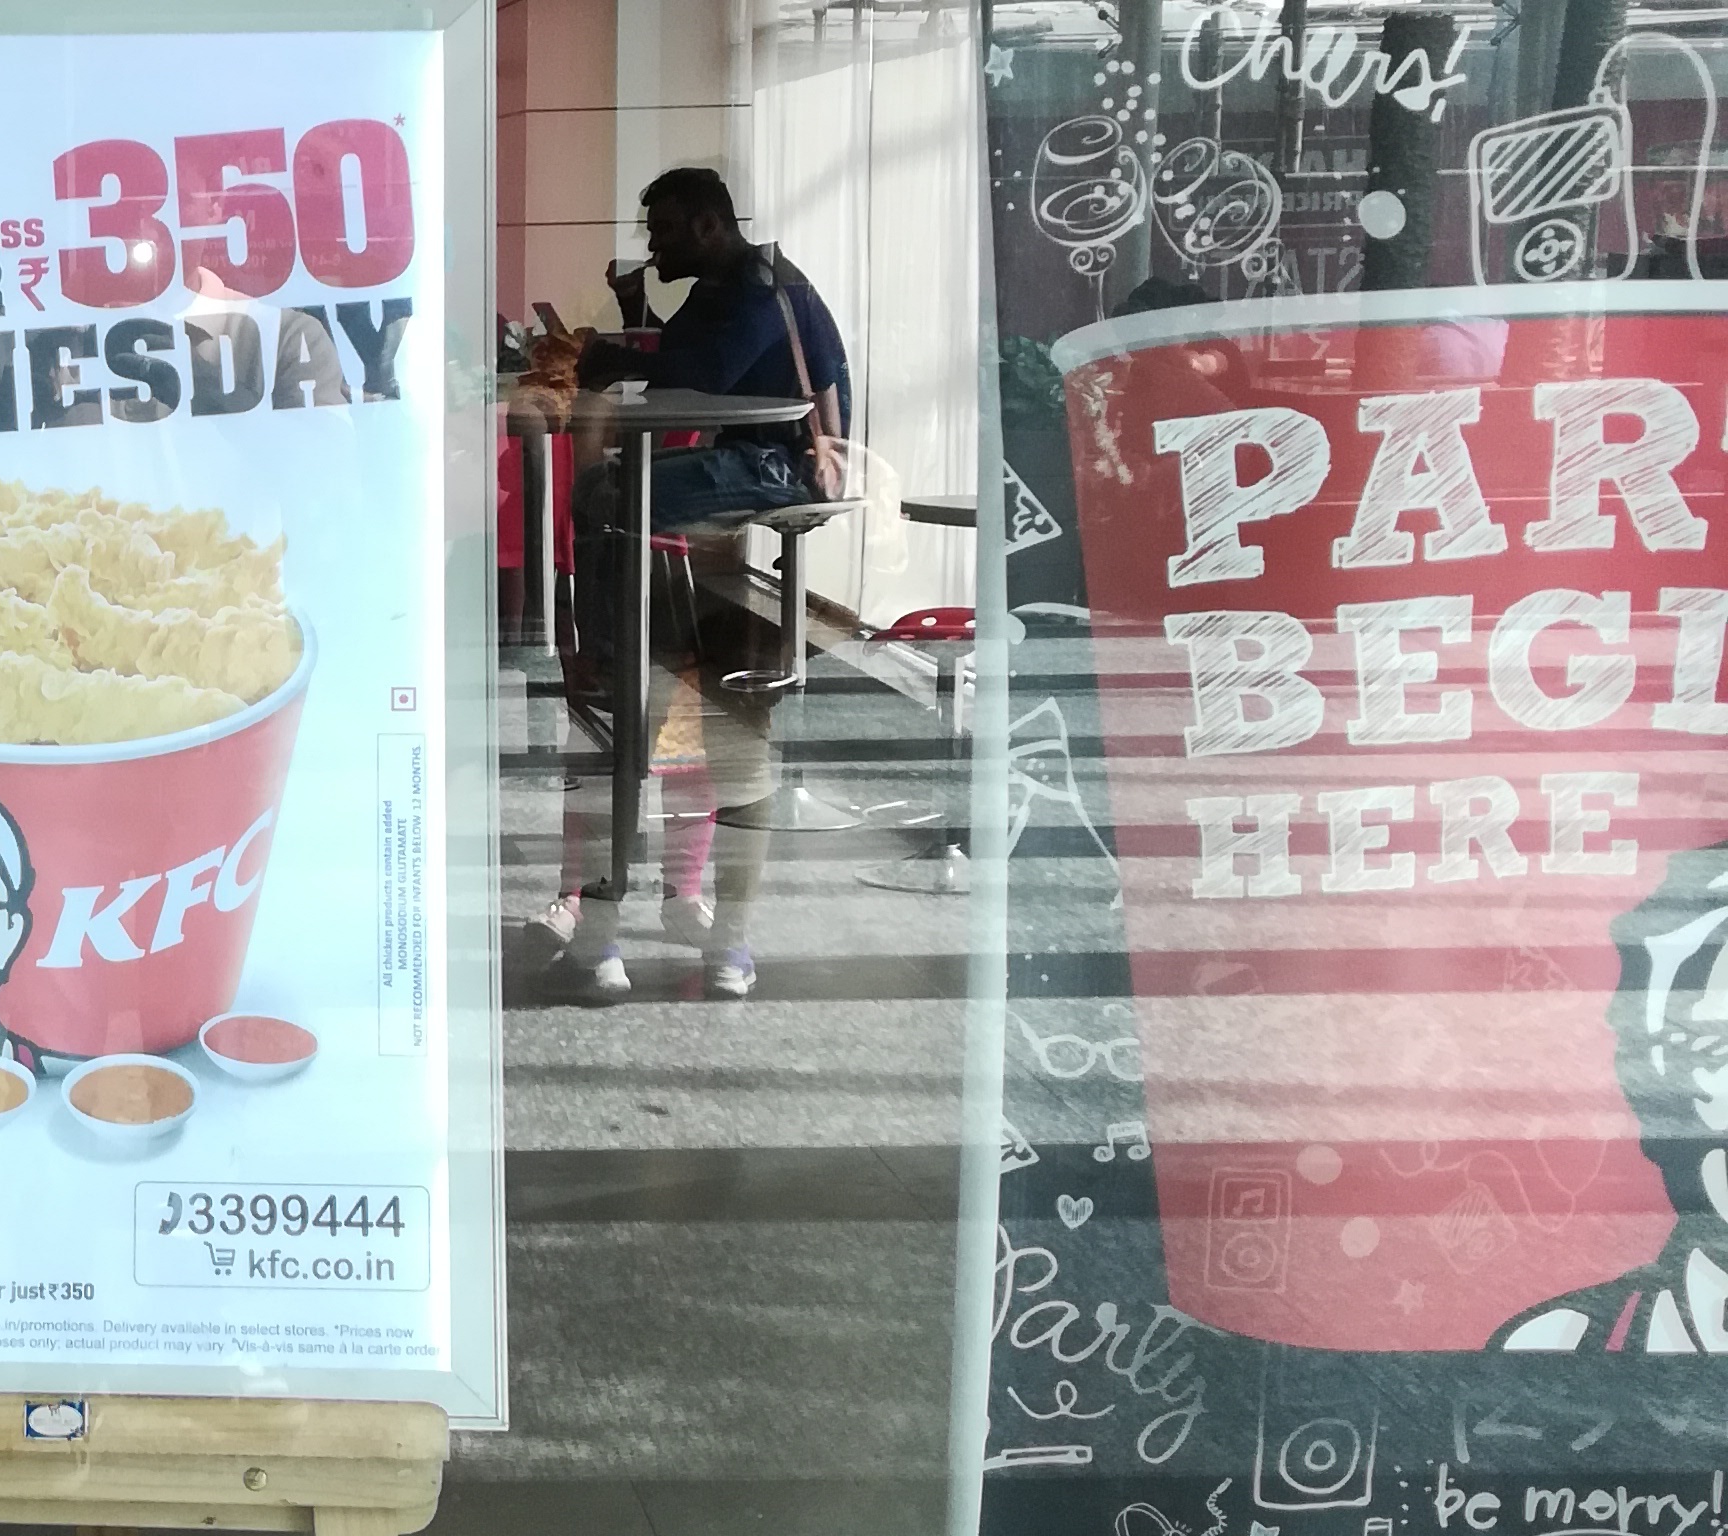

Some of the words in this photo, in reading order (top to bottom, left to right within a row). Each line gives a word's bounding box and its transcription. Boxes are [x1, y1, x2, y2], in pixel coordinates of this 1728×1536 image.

[1153, 377, 1728, 588] PAR
[383, 800, 393, 834] added
[1187, 771, 1639, 899] HERE
[36, 807, 271, 969] KFC
[383, 880, 395, 926] products
[383, 929, 393, 970] chicken
[188, 1193, 405, 1239] 3399444
[249, 1247, 395, 1282] kfc.co.in
[65, 1337, 105, 1350] actual
[110, 1338, 158, 1353] product
[104, 1321, 156, 1337] Delivery
[161, 1322, 220, 1334] available
[225, 1322, 236, 1334] in
[241, 1323, 279, 1335] select
[385, 1328, 413, 1338] now
[994, 1223, 1206, 1464] Party
[1434, 1464, 1500, 1528] be
